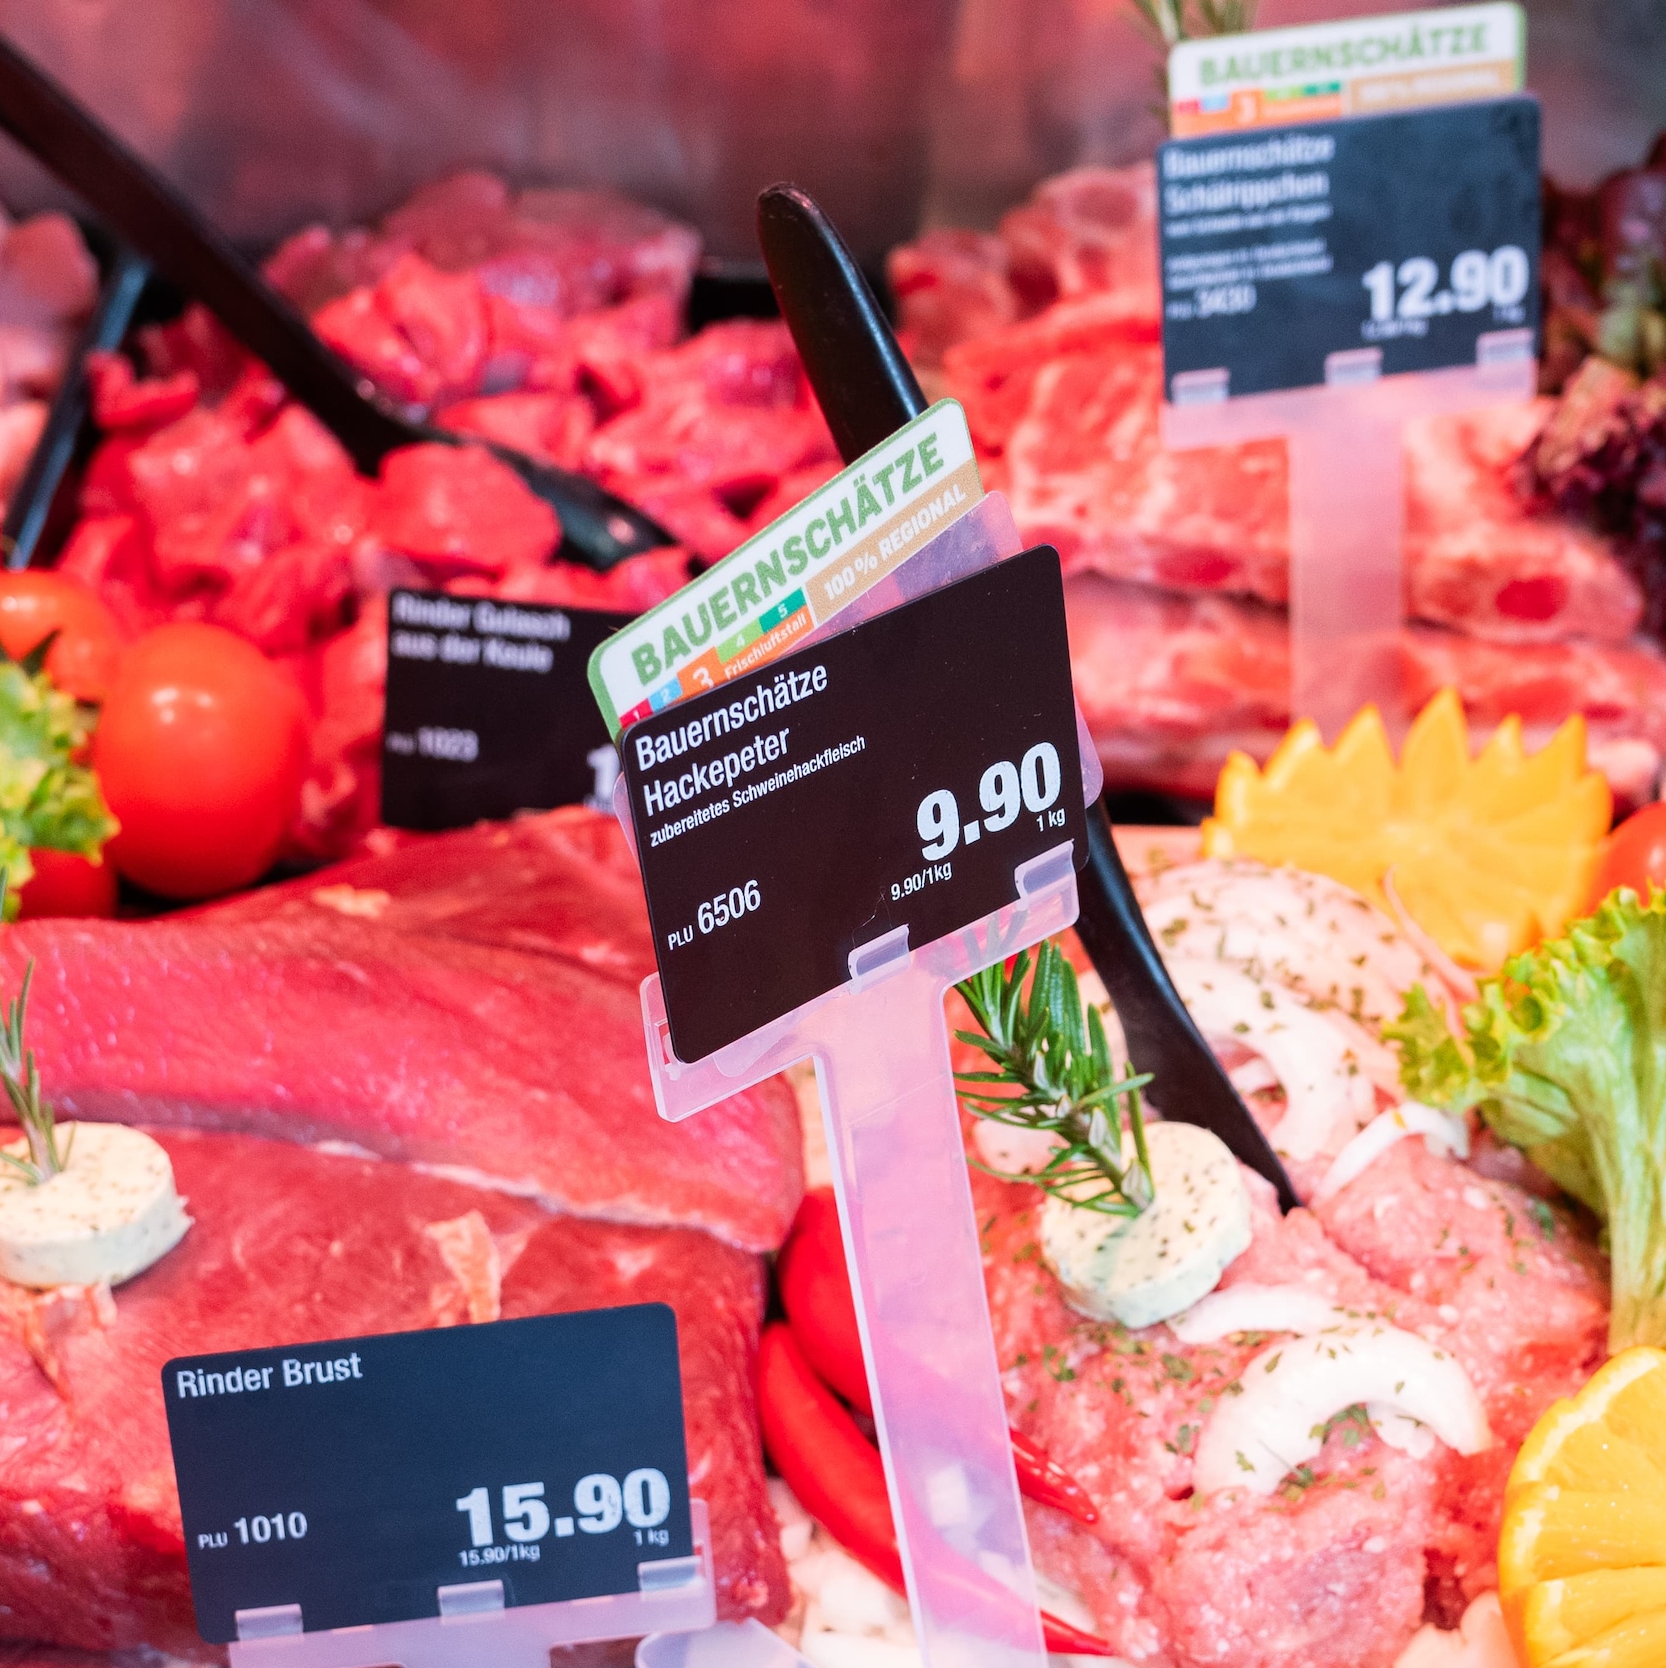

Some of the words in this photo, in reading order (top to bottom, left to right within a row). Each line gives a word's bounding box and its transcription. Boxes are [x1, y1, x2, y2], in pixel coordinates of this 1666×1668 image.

[1362, 245, 1529, 320] 12.90
[631, 432, 945, 687] BAUERNSCHÄTZE
[823, 567, 857, 602] 100
[856, 552, 879, 578] %
[878, 484, 967, 561] REGIONAL
[724, 612, 808, 681] Frischluftstall
[777, 603, 789, 619] 5
[635, 664, 829, 771] Bauernschätze
[643, 728, 791, 816] Hackepeter
[650, 798, 731, 848] zubereitetes
[732, 734, 867, 808] Schweinehackfleisch
[916, 741, 1062, 862] 9.90
[1036, 813, 1045, 832] 1
[1047, 806, 1067, 829] kg
[668, 924, 694, 950] PLU
[696, 879, 761, 936] 6506
[890, 861, 953, 902] 9.90/1kg
[176, 1365, 274, 1399] Rinder
[282, 1352, 363, 1388] Brust
[197, 1530, 228, 1550] PLU
[234, 1511, 308, 1546] 1010
[456, 1467, 671, 1547] 15.90
[634, 1530, 644, 1546] 1
[646, 1525, 669, 1548] kg
[459, 1541, 541, 1566] 15.90/1kg
